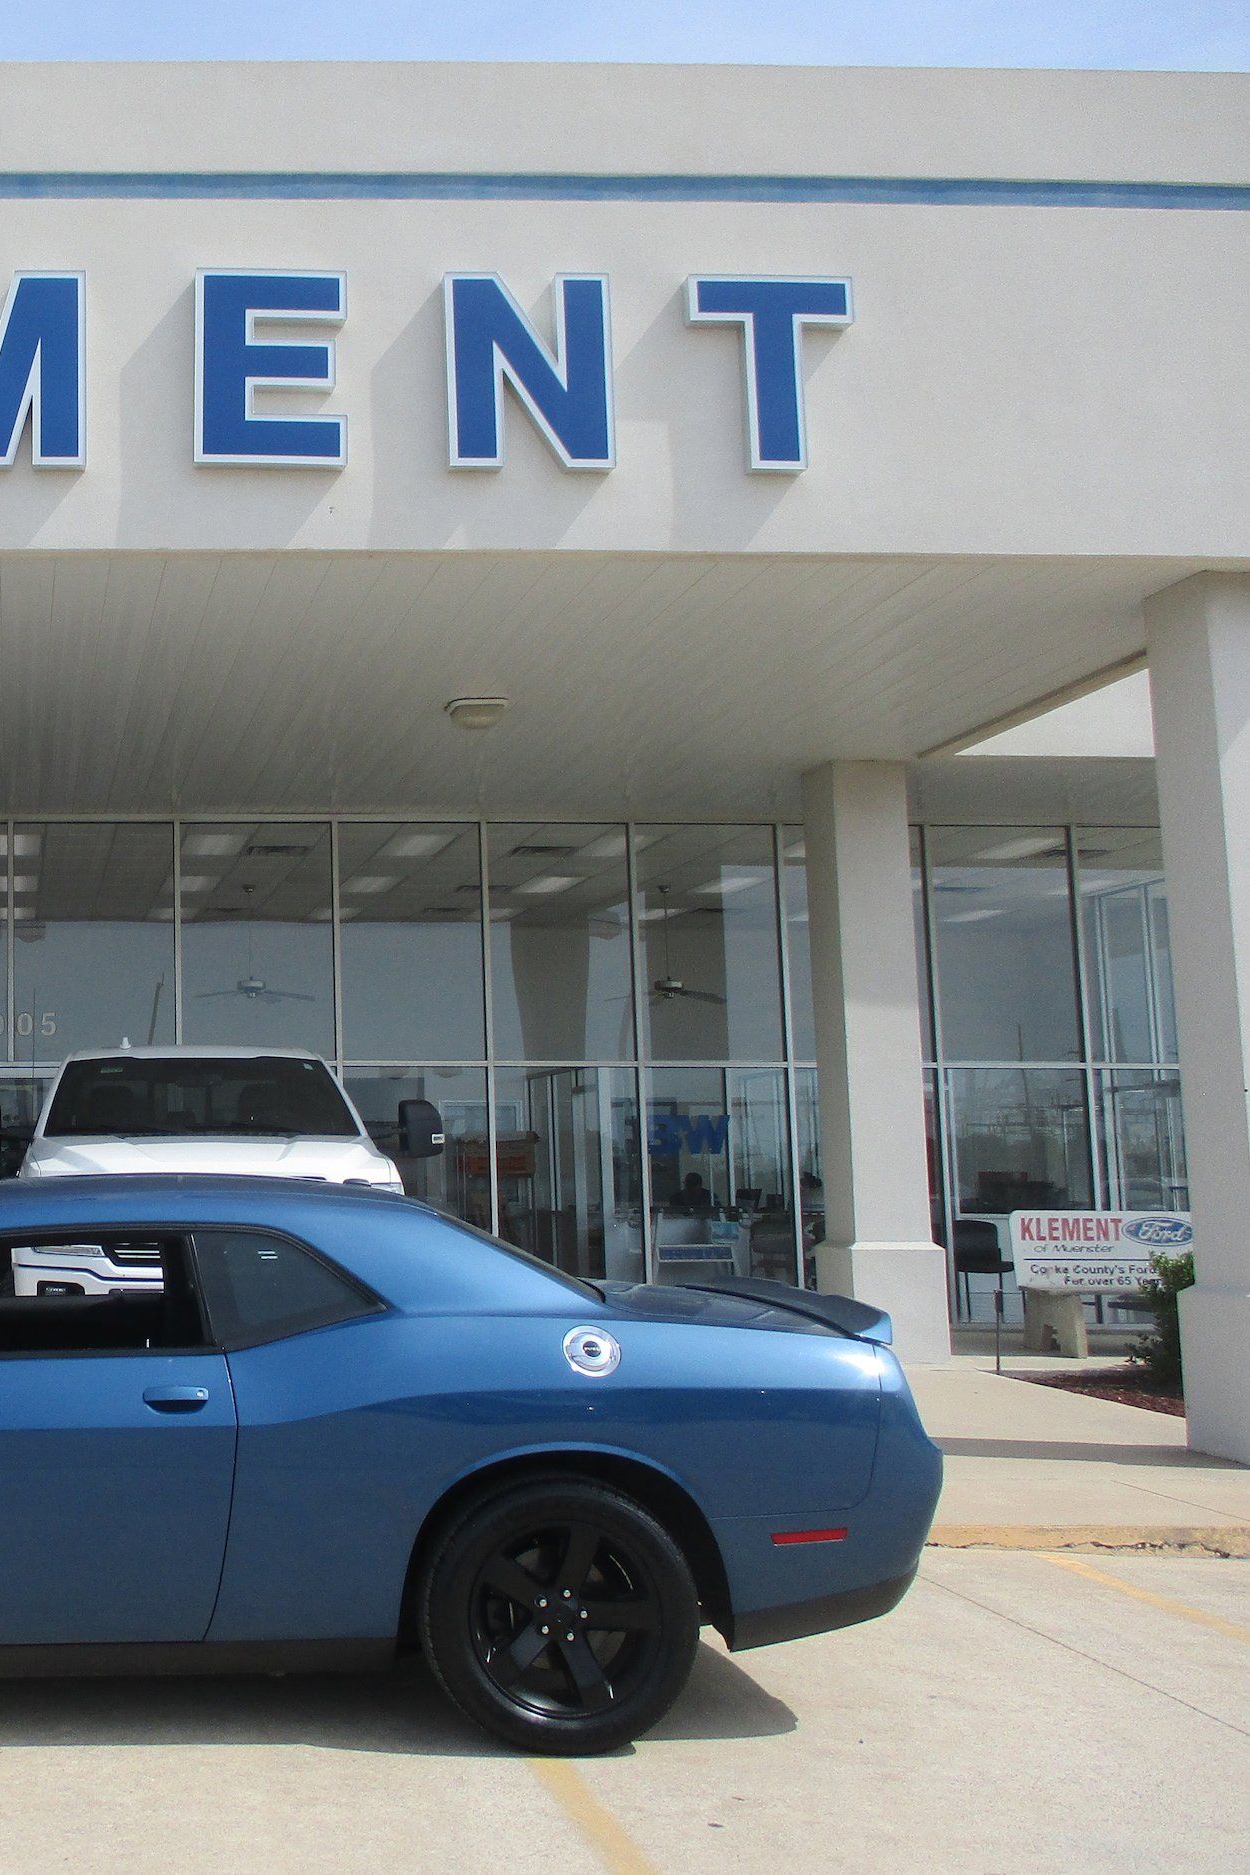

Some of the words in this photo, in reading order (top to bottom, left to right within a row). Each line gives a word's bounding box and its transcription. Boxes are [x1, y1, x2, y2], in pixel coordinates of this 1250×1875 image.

[1020, 1217, 1122, 1242] KLEMENT
[1138, 1220, 1184, 1243] Ford
[1034, 1243, 1047, 1253] of
[1030, 1264, 1069, 1274] Coke
[1073, 1264, 1125, 1275] County's
[1088, 1278, 1114, 1286] over
[1117, 1277, 1131, 1286] 65
